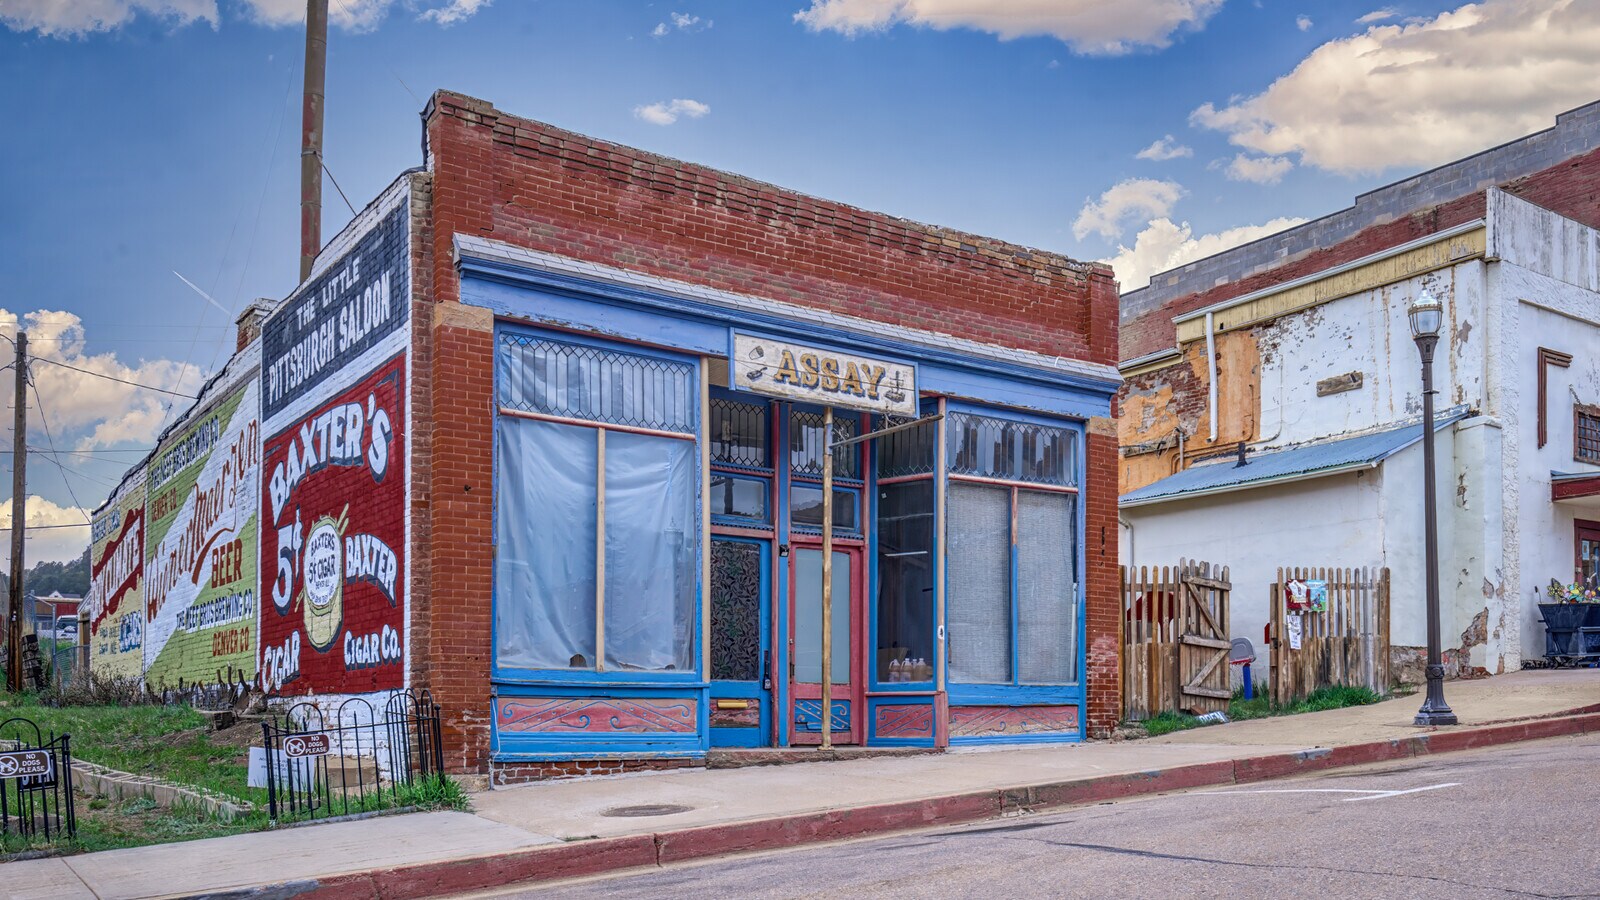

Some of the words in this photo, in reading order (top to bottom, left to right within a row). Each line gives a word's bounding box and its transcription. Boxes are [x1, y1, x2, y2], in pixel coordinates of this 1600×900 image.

[296, 296, 315, 330] THE
[322, 257, 360, 308] LITTLE
[269, 316, 335, 405] PITTSBURGH
[339, 270, 390, 352] SALOON
[774, 349, 886, 400] ASSAY
[269, 391, 393, 529] BAXTER'S
[212, 538, 242, 589] BEER
[272, 504, 304, 616] 5¢
[317, 556, 336, 580] CIGAR
[345, 533, 398, 608] BAXTER
[176, 610, 185, 631] THE
[200, 600, 214, 631] BROS
[214, 591, 243, 627] BREWING
[244, 588, 253, 620] CO
[213, 628, 238, 656] DENVER
[240, 626, 249, 652] CO
[262, 629, 300, 694] CIGAR
[344, 630, 382, 671] CIGAR
